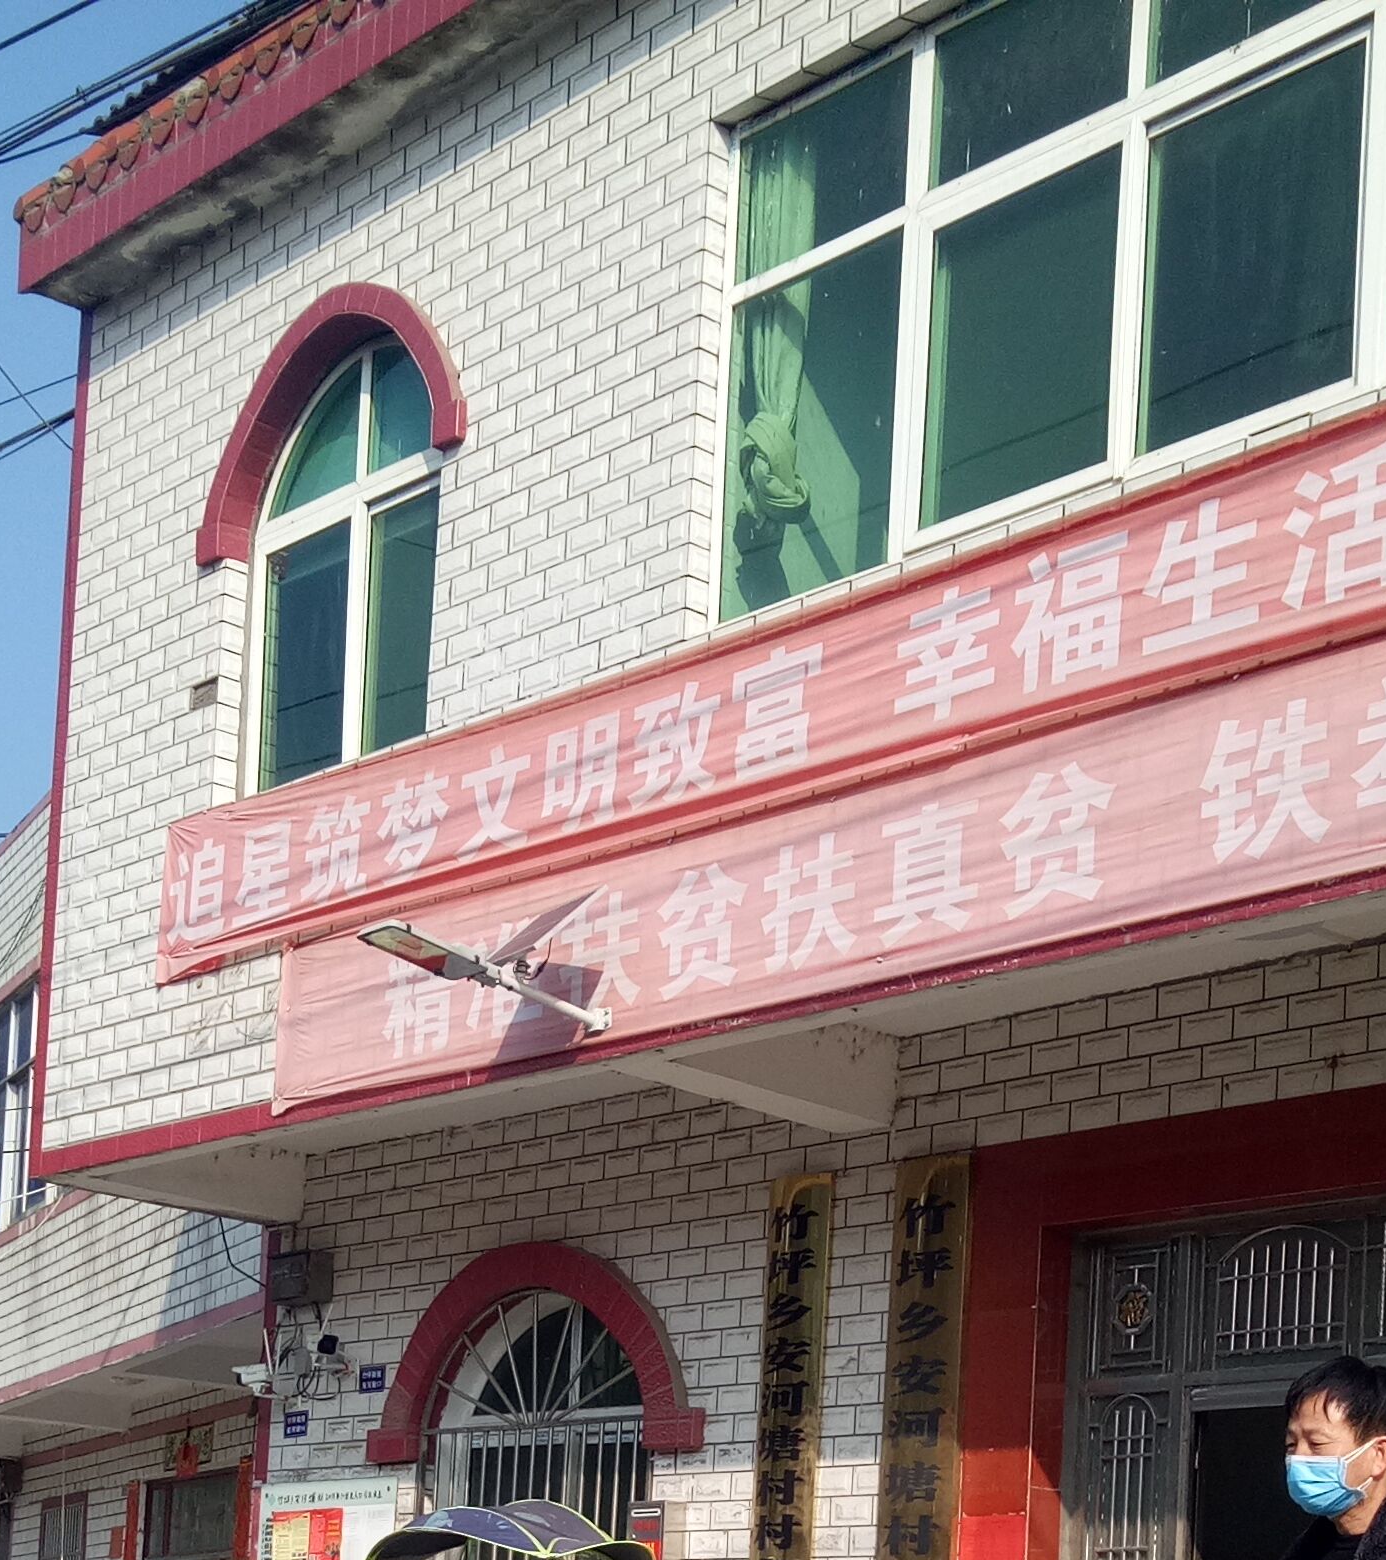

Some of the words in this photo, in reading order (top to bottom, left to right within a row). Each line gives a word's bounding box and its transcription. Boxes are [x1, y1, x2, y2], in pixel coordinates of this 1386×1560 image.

[169, 638, 823, 945] 追星筑梦文明致富
